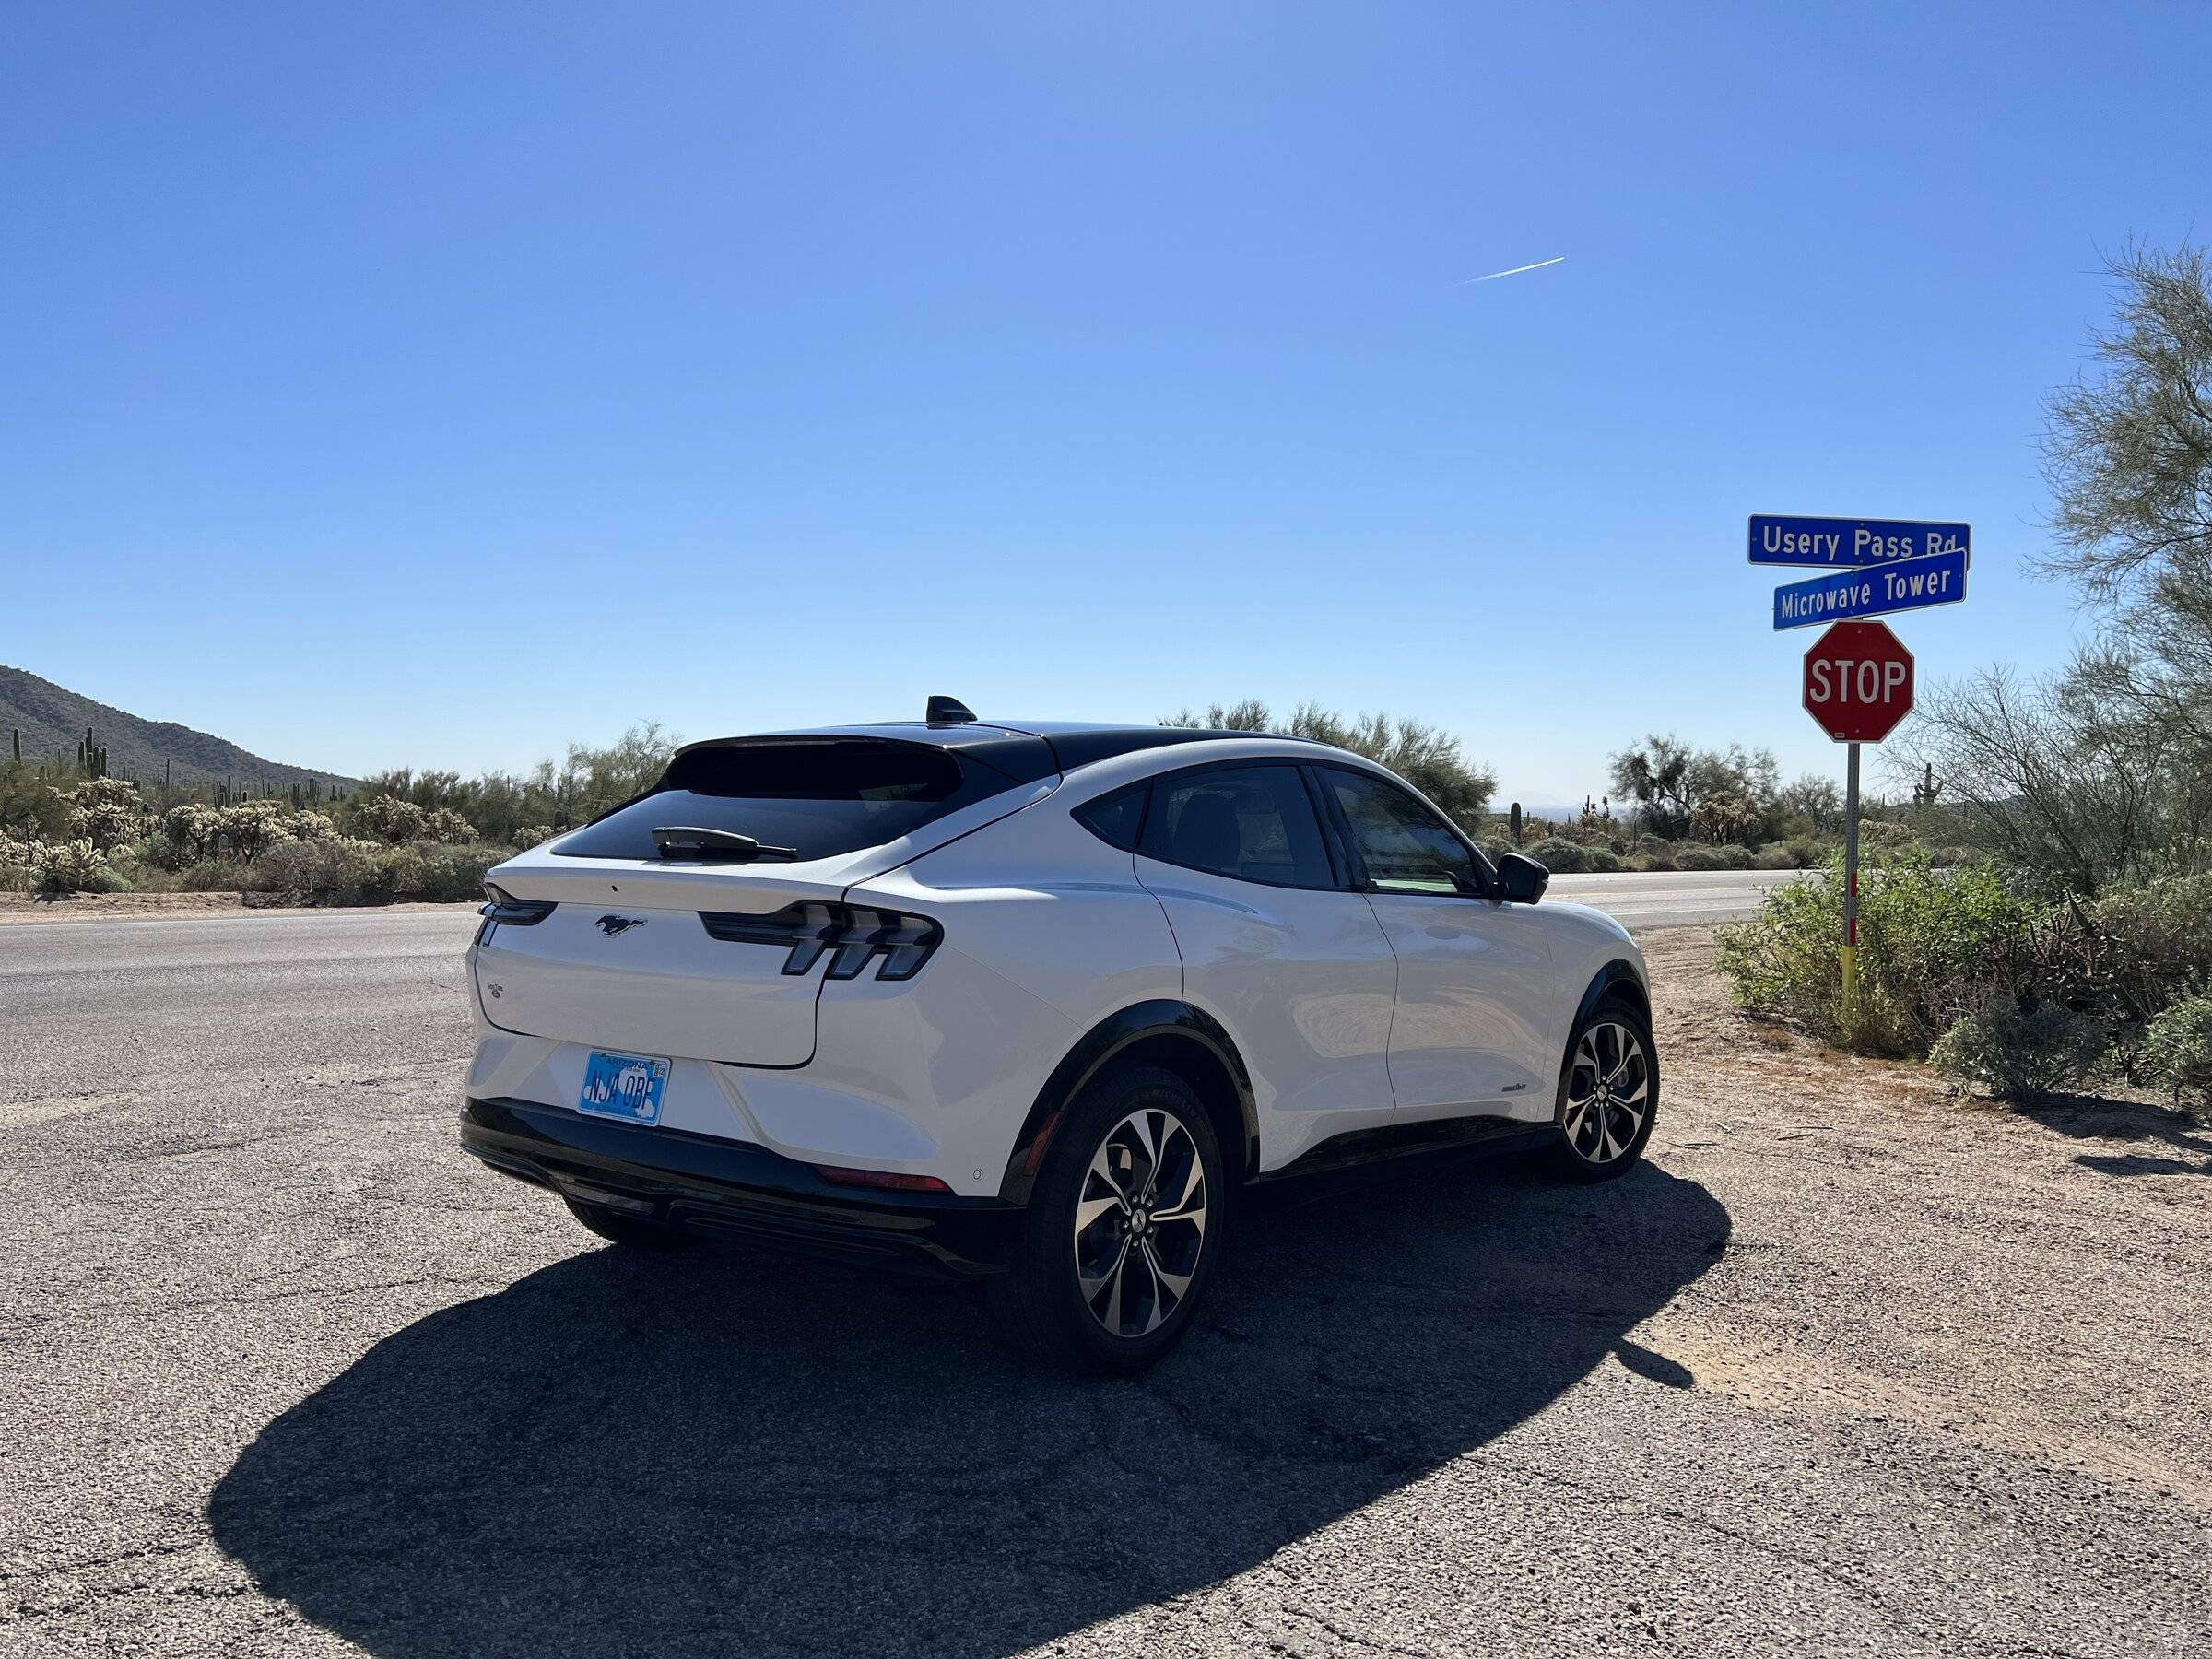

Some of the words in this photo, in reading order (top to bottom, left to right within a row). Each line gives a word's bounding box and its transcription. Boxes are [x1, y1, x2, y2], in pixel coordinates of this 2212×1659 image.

[1762, 524, 1840, 561] Usery
[1853, 529, 1912, 559] Pass
[1781, 582, 1872, 619] Microwave
[1884, 569, 1952, 601] Tower
[1809, 658, 1907, 704] STOP
